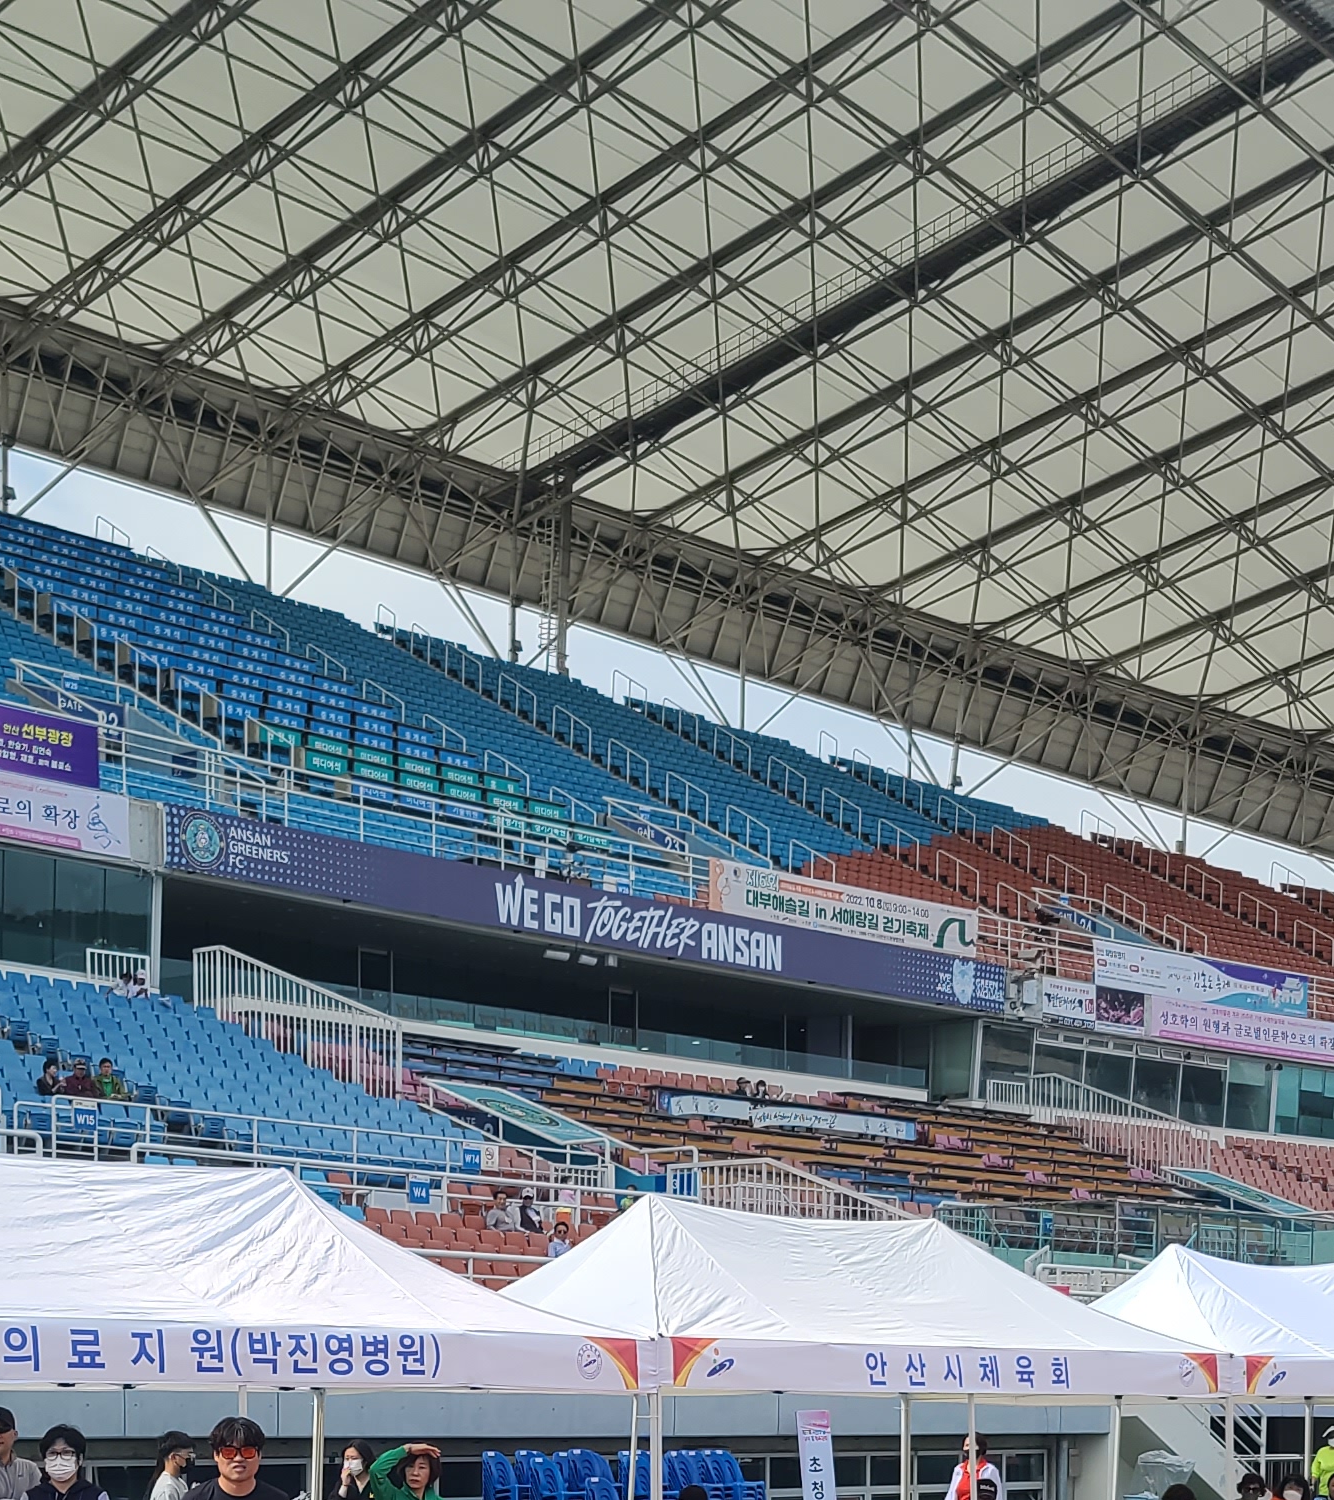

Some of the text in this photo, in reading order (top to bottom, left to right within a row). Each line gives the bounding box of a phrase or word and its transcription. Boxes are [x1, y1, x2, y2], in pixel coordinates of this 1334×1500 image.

[21, 723, 73, 748] 선부광장
[312, 756, 342, 773] 미디어석
[360, 767, 388, 782] 미디어석
[406, 778, 434, 792] 미디어석
[450, 787, 476, 800] 미디어석
[42, 804, 81, 830] 확장
[534, 806, 560, 819] 미디어석
[228, 827, 271, 847] ANSAN
[229, 841, 289, 864] GREENERS
[229, 854, 246, 869] FC
[746, 868, 779, 892] 제6회
[495, 873, 539, 930] WE
[544, 892, 581, 937] GO
[585, 896, 700, 956] TOGETHER
[701, 922, 782, 972] ANSAN
[815, 903, 827, 920] in
[830, 906, 879, 931] 서해랑길
[882, 916, 930, 941] 걷기축제
[1159, 1010, 1199, 1032] 성호학의
[76, 1113, 96, 1126] W15
[464, 1153, 480, 1164] W14
[412, 1186, 427, 1199] W4
[864, 1351, 1071, 1390] 안산시체육회
